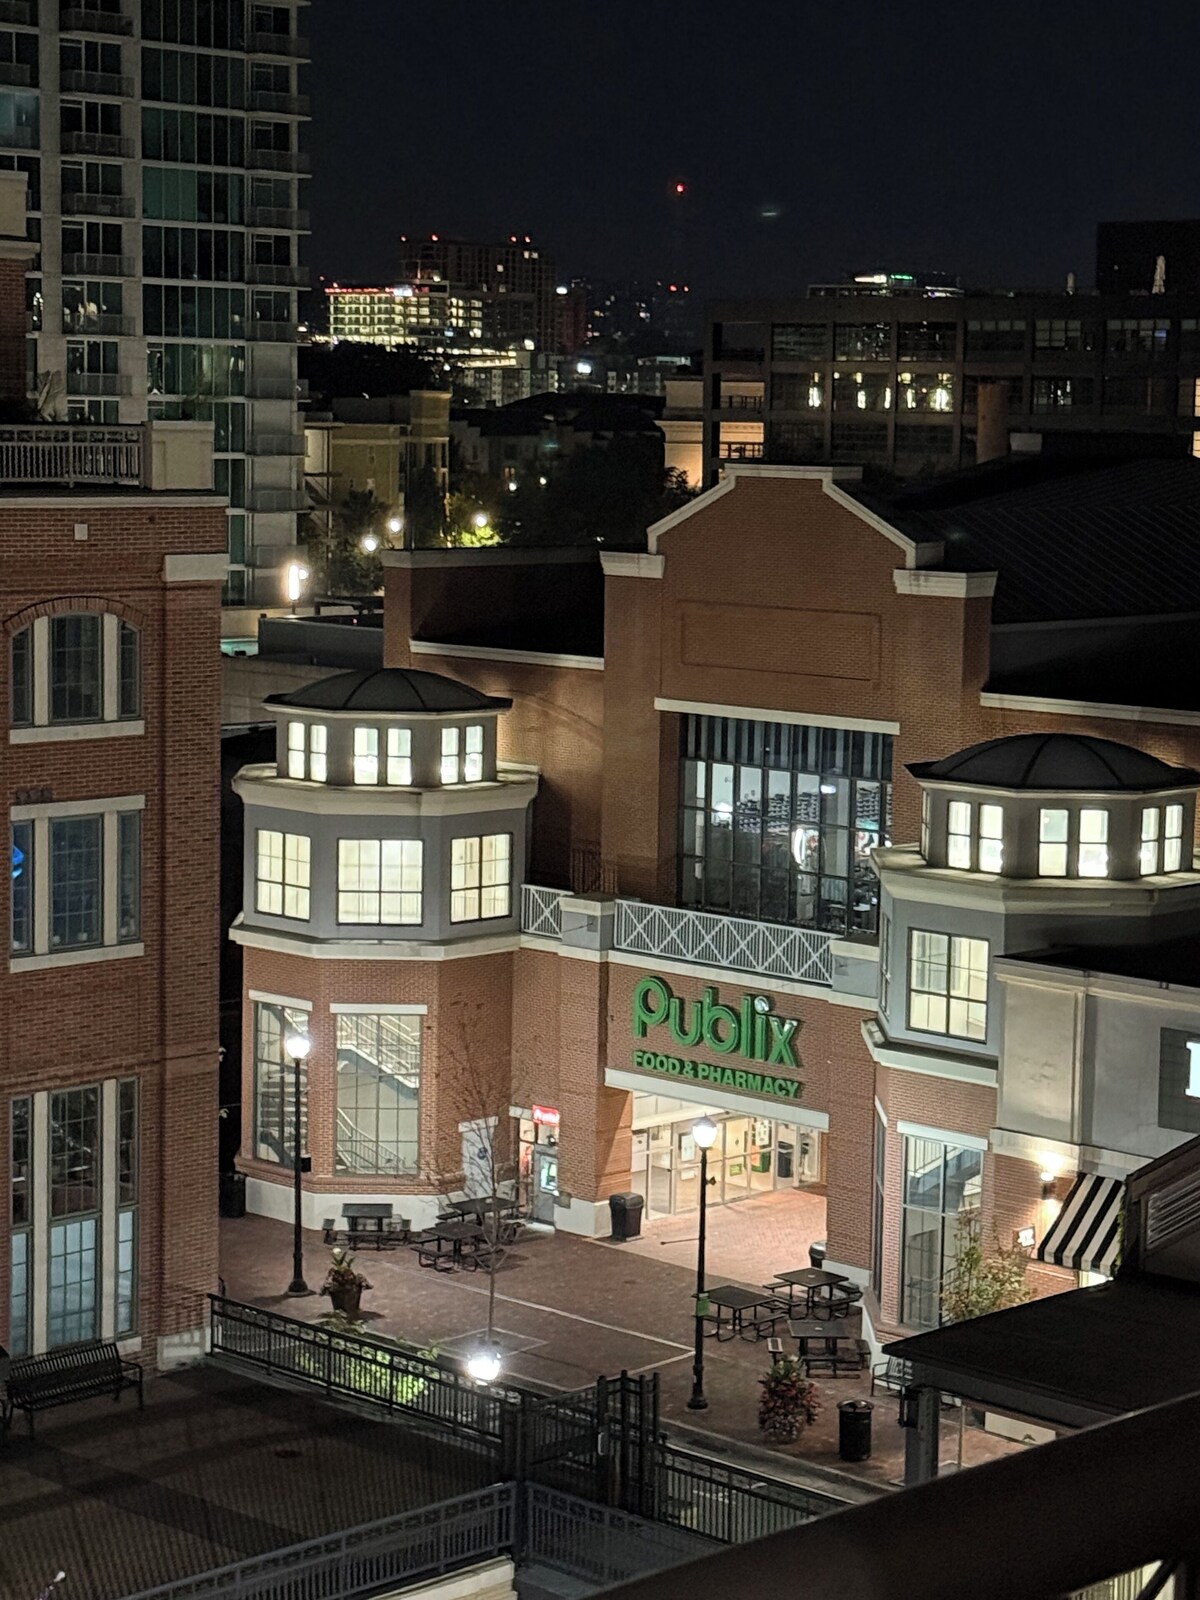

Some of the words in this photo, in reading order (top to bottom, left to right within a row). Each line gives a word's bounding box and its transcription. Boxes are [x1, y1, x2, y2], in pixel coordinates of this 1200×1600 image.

[633, 976, 798, 1067] Publix
[634, 1051, 681, 1075] FOOD
[683, 1061, 695, 1079] &
[698, 1063, 799, 1098] PHARMACY
